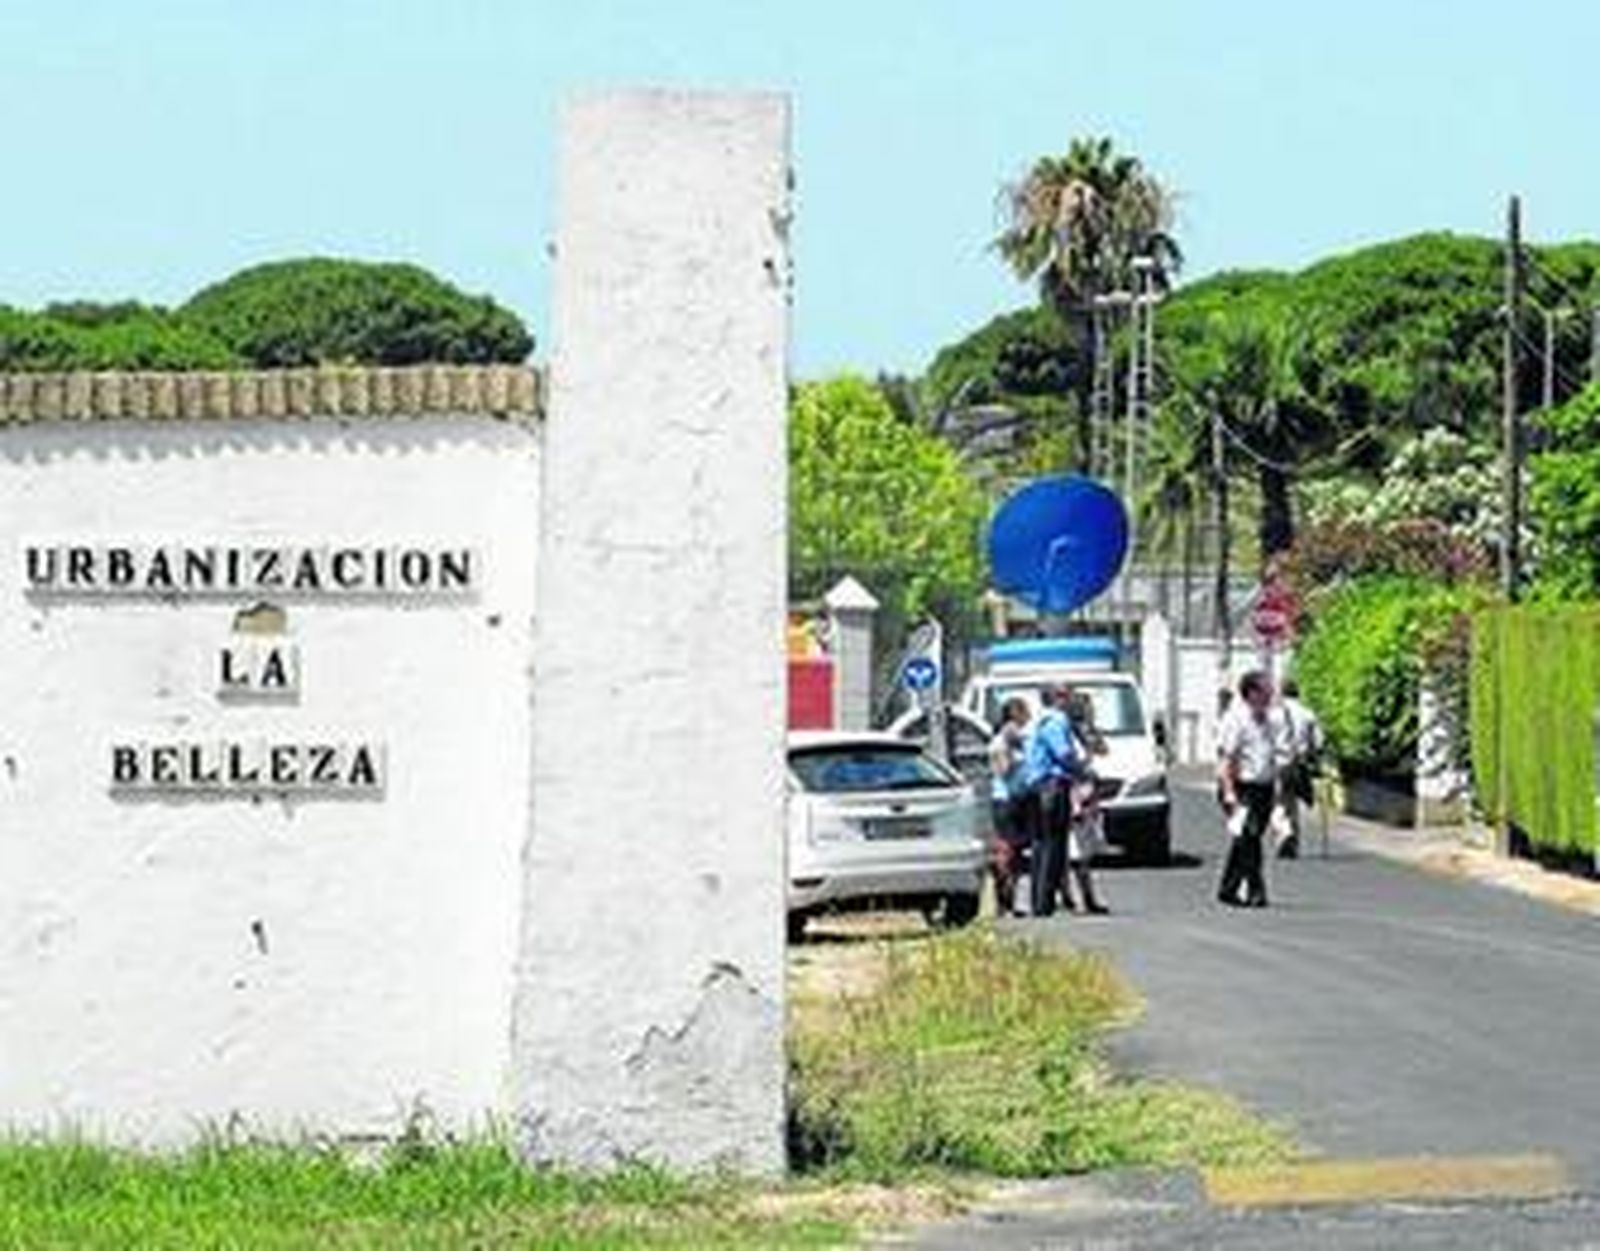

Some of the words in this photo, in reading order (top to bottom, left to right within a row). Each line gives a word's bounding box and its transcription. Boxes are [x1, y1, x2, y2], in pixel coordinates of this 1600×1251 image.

[26, 547, 472, 588] URBANIZACION
[220, 649, 288, 687] LA
[111, 745, 377, 785] BELLEZA
